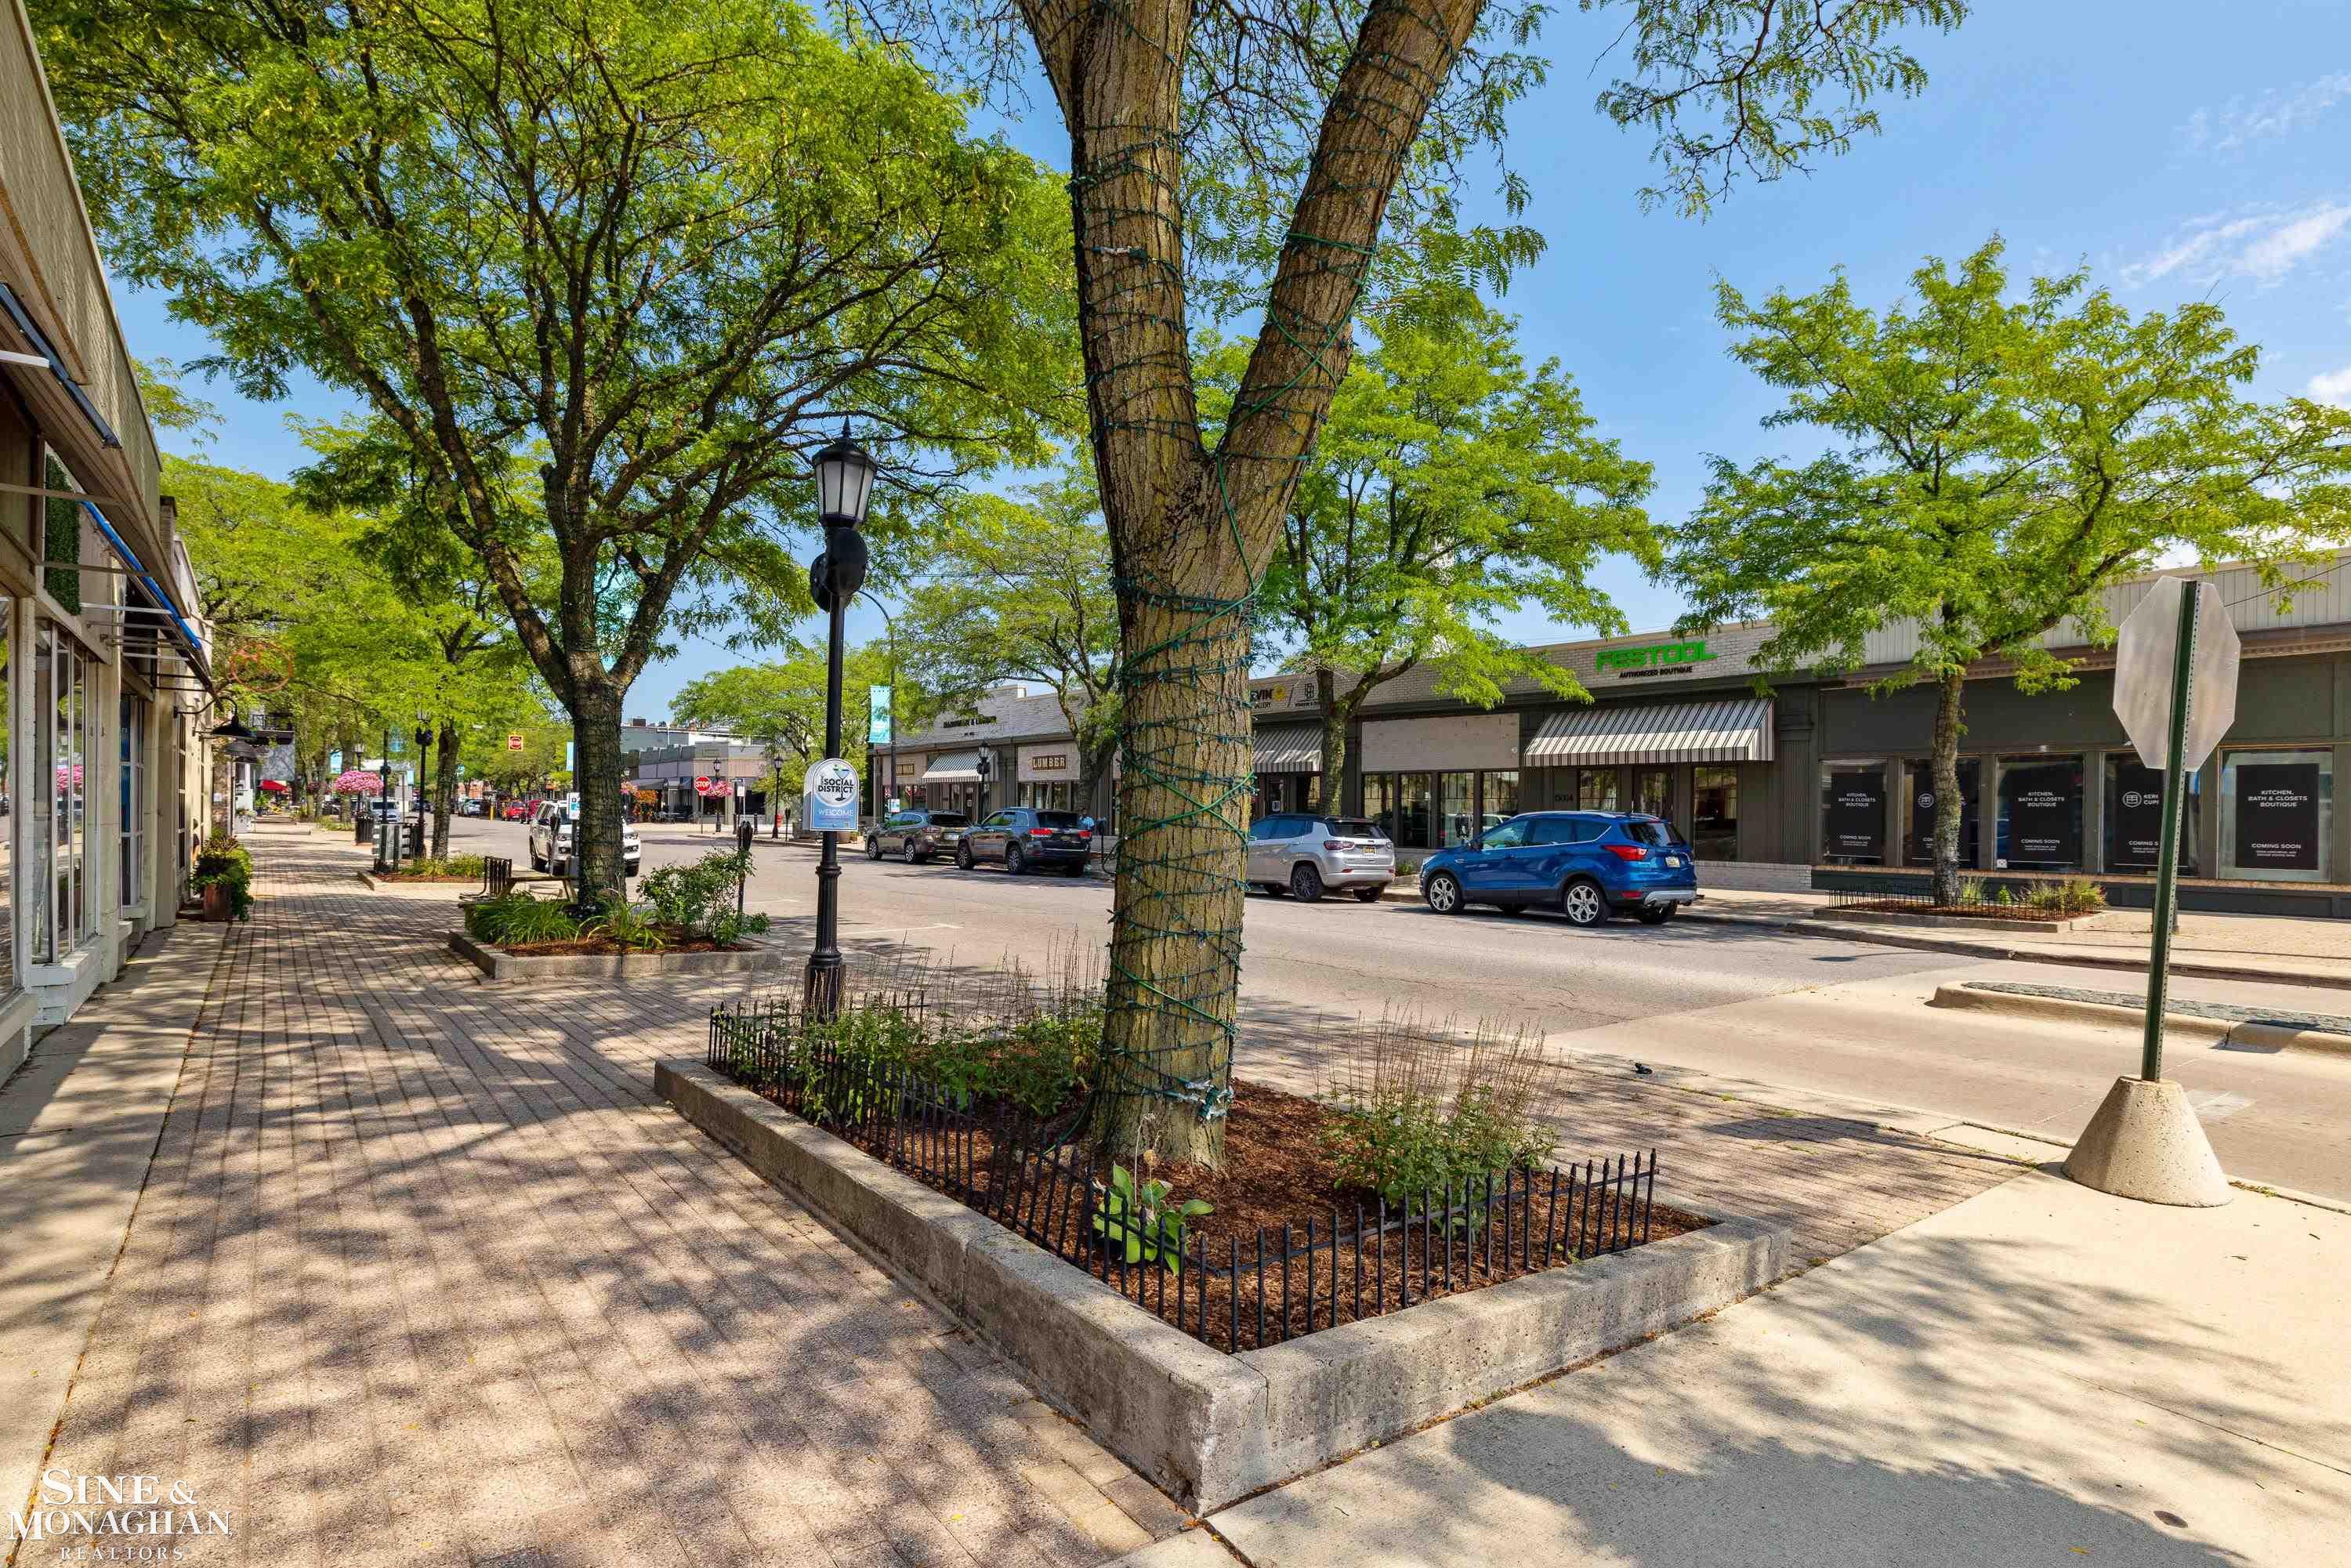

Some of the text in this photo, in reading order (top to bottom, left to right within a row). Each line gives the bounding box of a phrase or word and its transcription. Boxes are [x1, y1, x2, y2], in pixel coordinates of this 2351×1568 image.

[1596, 640, 1719, 672] FESTOOL
[1619, 665, 1693, 679] AUTHORIZED BOUTIQUE
[1033, 757, 1065, 768] LUMBER
[824, 778, 854, 787] SOCIAL
